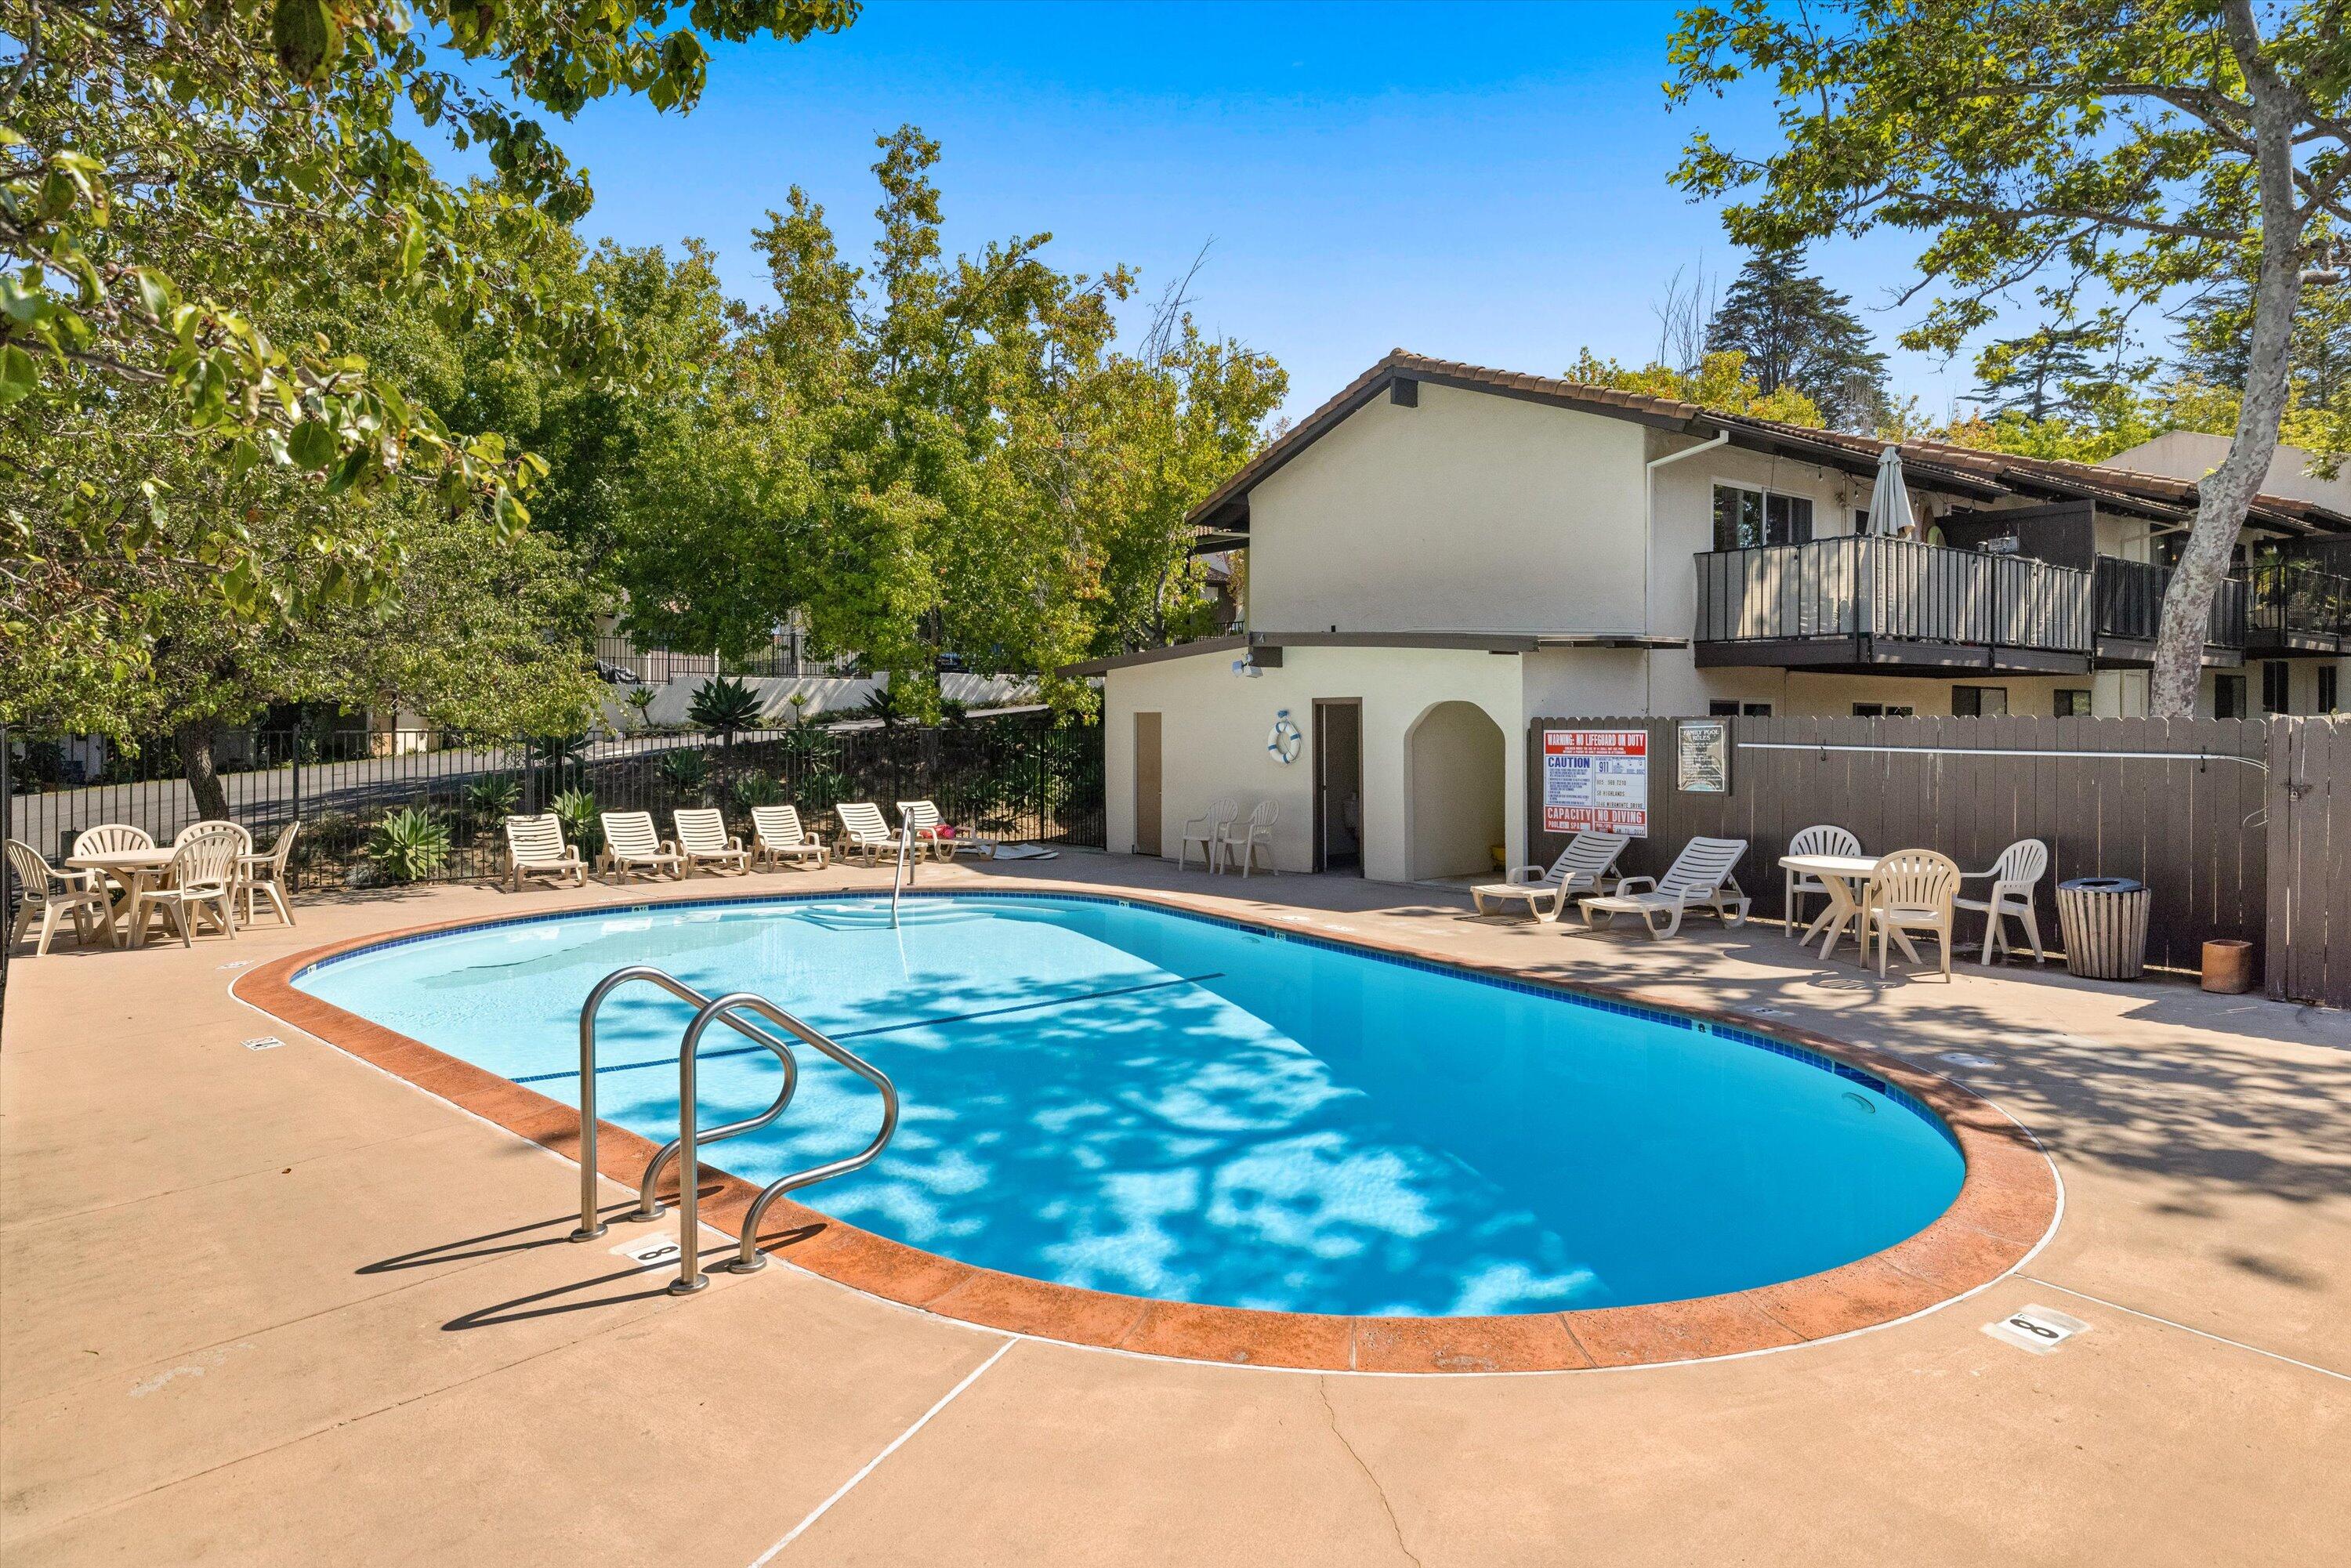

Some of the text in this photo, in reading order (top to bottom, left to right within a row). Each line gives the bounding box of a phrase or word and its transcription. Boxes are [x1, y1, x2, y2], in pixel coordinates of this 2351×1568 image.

[1548, 733, 1644, 747] WARNING: NO LIFEGUARD ON DUTY
[1549, 757, 1590, 768] CAUTION
[1599, 762, 1609, 773] 911
[1547, 808, 1592, 820] CAPACITY
[1597, 809, 1643, 824] NO DIVING
[638, 1246, 679, 1260] 8
[2009, 1319, 2059, 1338] 8
